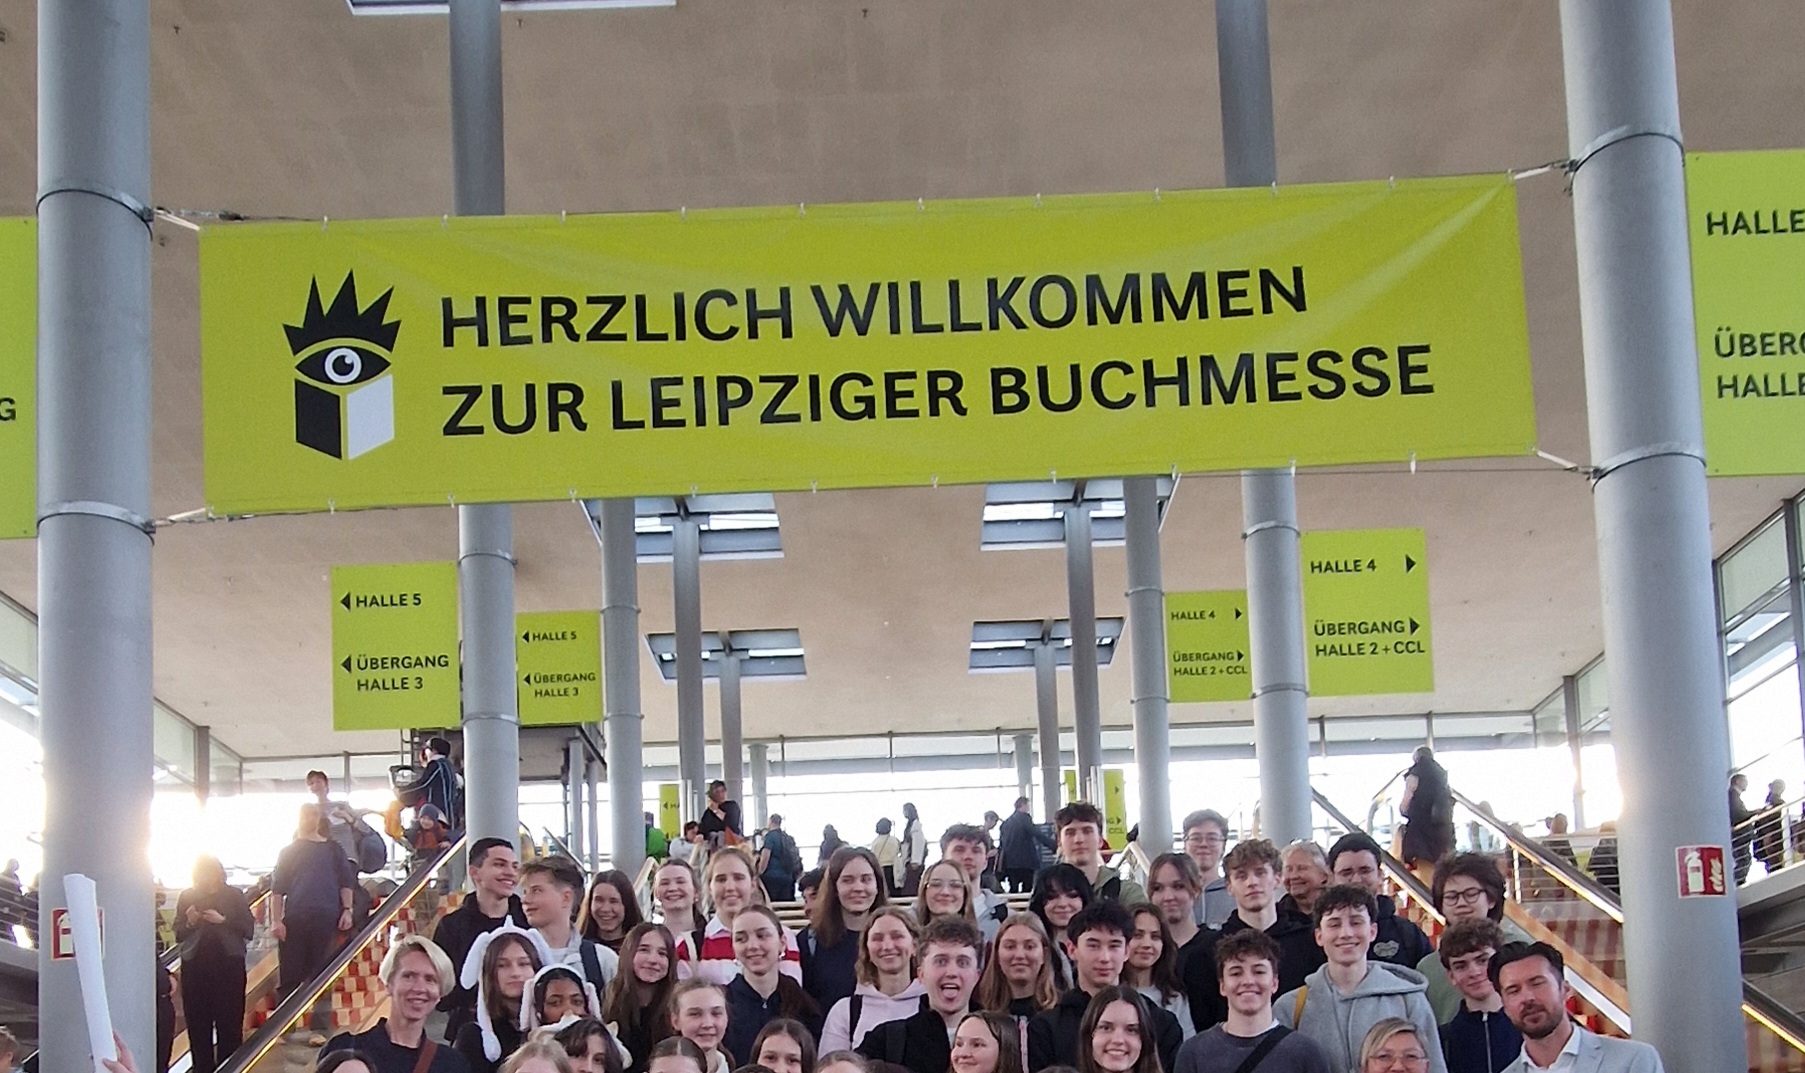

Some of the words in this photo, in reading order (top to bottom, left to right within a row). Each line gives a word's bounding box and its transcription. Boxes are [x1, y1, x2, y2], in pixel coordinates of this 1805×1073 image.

[1706, 209, 1805, 236] HALLE
[441, 286, 793, 348] HERZLICH
[810, 265, 1308, 338] WILLKOMMEN
[1714, 326, 1805, 358] ÜBER
[442, 382, 588, 437] ZUR
[611, 369, 968, 430] LEIPZIGER
[990, 344, 1435, 415] BUCHMESSE
[1310, 559, 1362, 573] HALLE
[1366, 559, 1377, 571] 4
[356, 593, 408, 607] HALLE
[412, 593, 422, 606] 5
[1171, 611, 1206, 620] HALLE
[1208, 610, 1216, 619] 4
[1314, 619, 1405, 636] ÜBERGANG
[532, 631, 567, 641] HALLE
[570, 631, 577, 640] 5
[1315, 642, 1366, 657] HALLE
[1369, 642, 1379, 655] 2
[1393, 640, 1426, 654] CCL
[357, 654, 449, 671] ÜBERGANG
[1173, 650, 1235, 662] ÜBERGANG
[1173, 666, 1208, 676] HALLE
[1210, 666, 1217, 675] 2
[1226, 665, 1248, 675] CCL
[357, 677, 410, 691] HALLE
[414, 676, 424, 690] 3
[533, 672, 597, 684] ÜBERGANG
[534, 688, 570, 698] HALLE
[572, 687, 579, 696] 3
